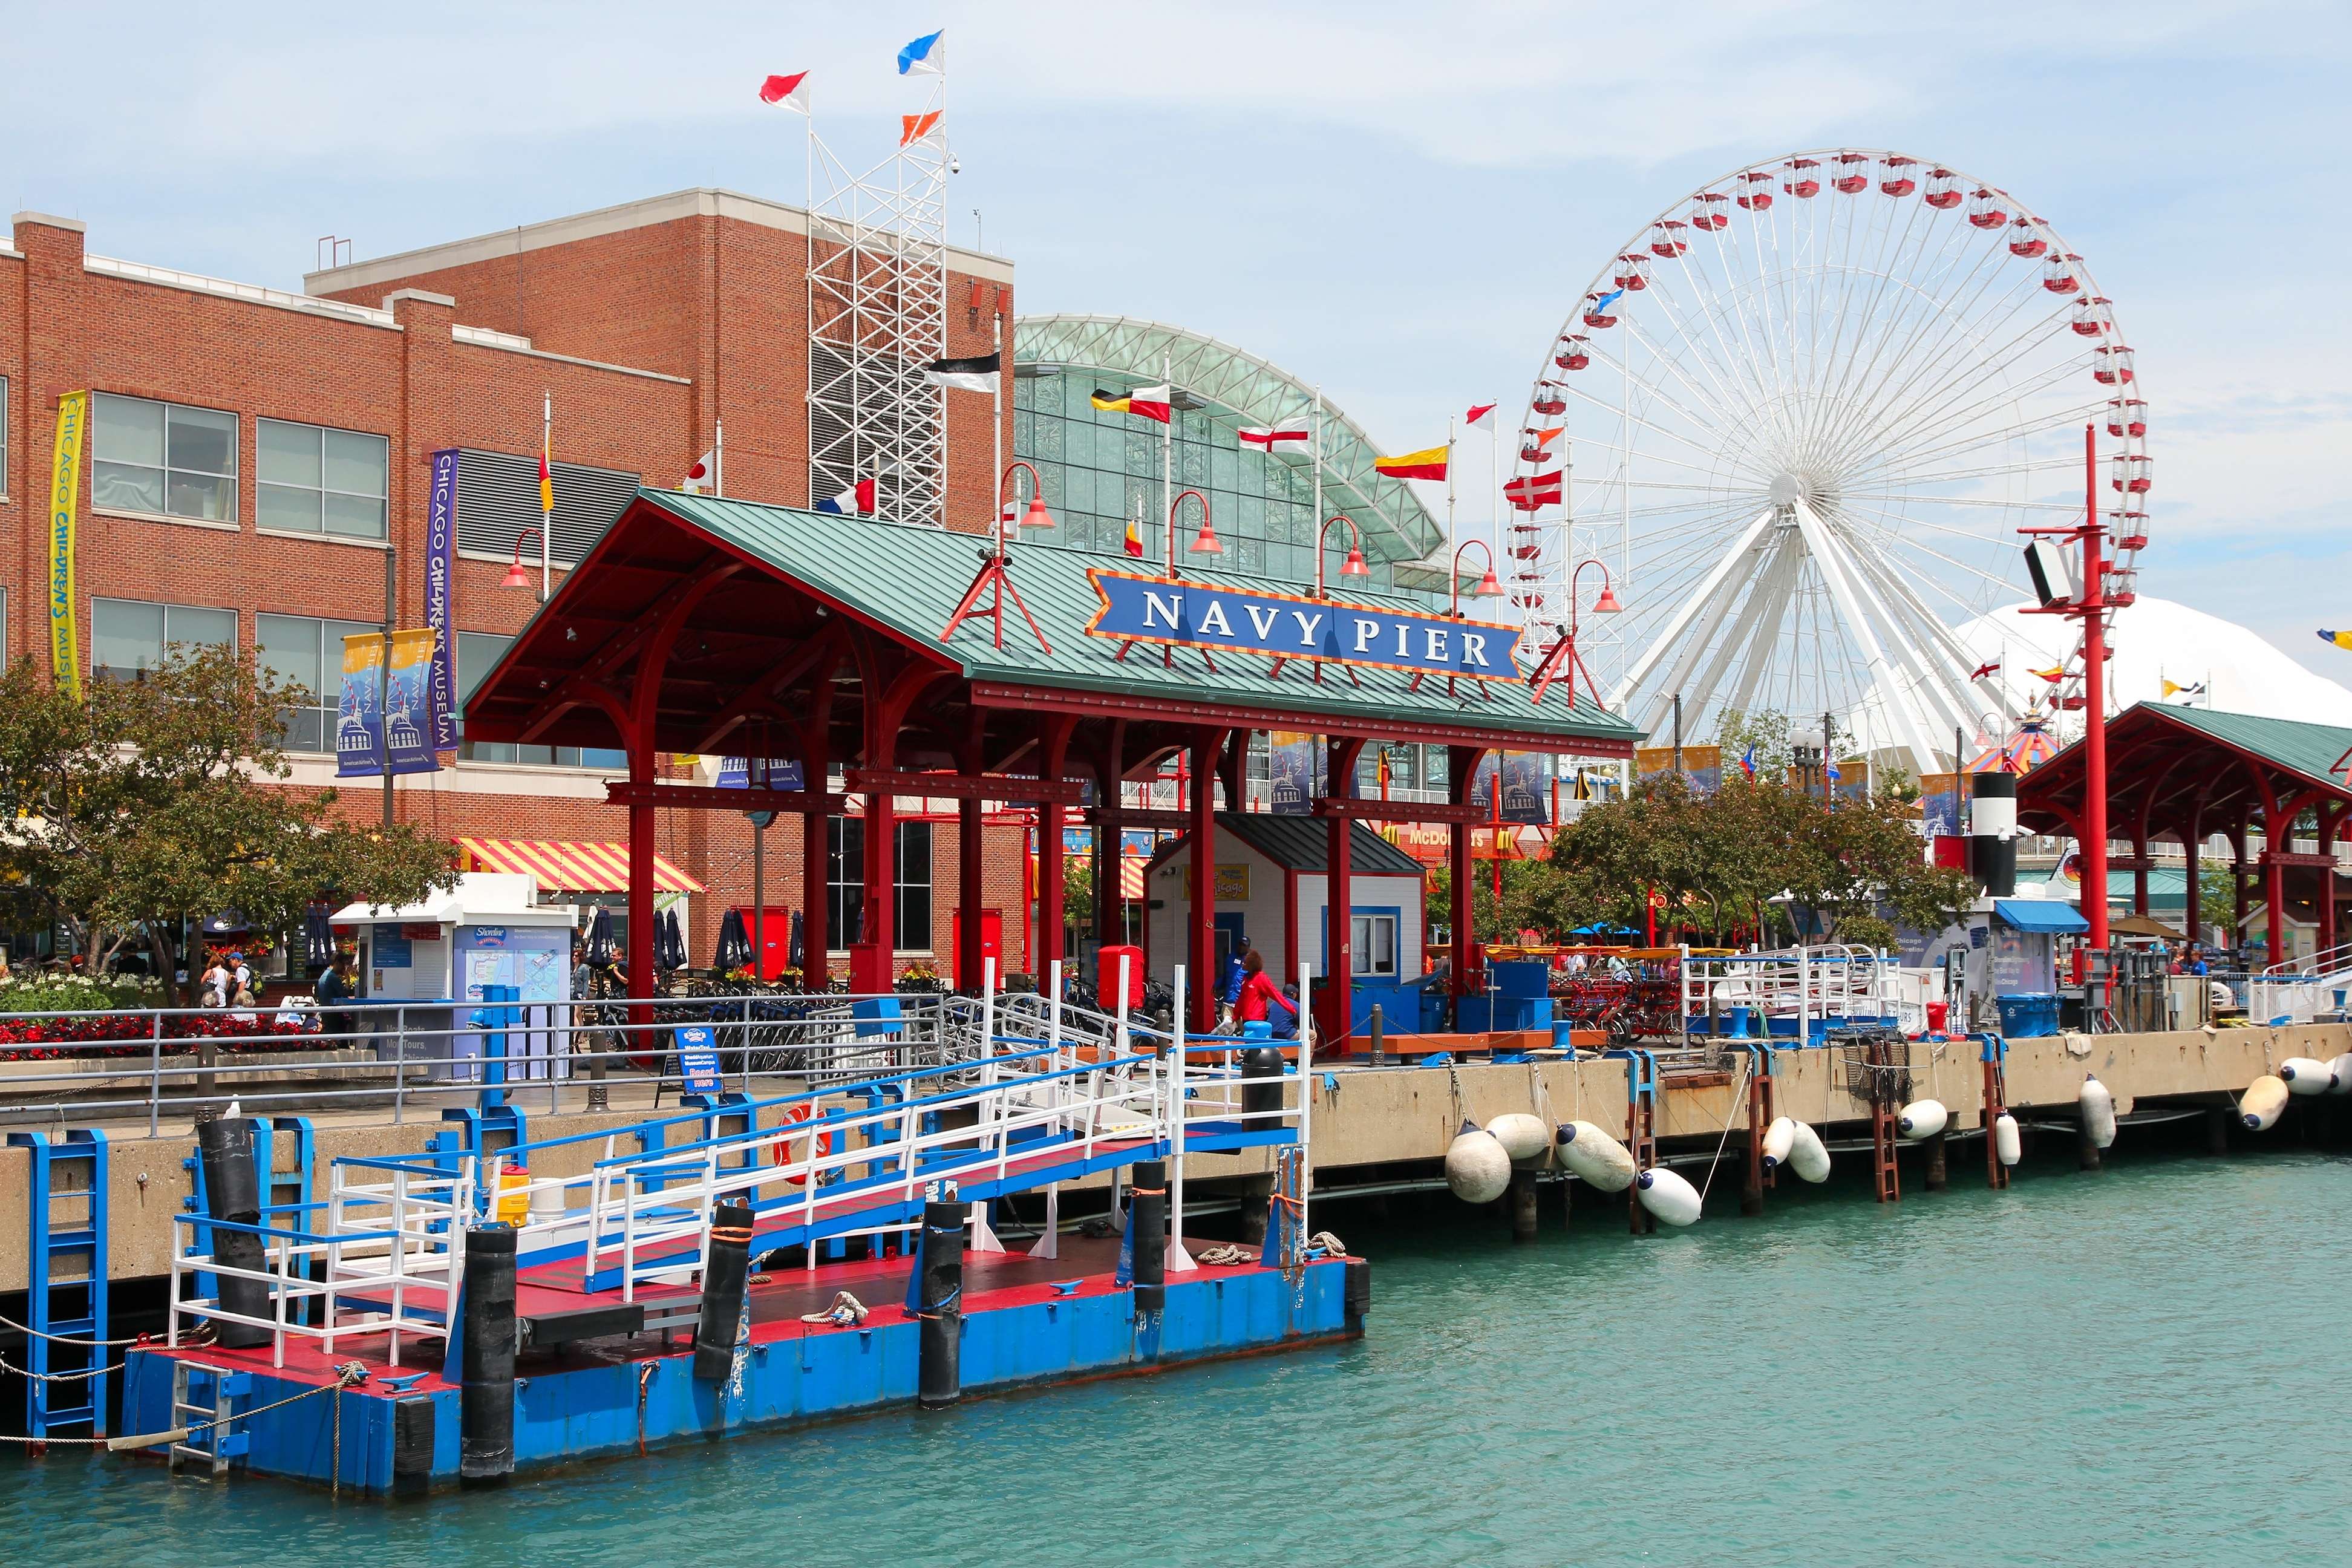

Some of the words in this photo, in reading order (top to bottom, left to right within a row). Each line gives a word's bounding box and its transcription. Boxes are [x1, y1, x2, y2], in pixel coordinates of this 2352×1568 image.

[58, 399, 77, 503] CHICAGO
[433, 455, 451, 550] CHICAGO
[52, 512, 68, 619] CHILDREN'S
[429, 556, 446, 653] CHILDREN'S
[1142, 591, 1323, 646] NAVY
[1354, 619, 1490, 667] PIER
[58, 627, 73, 688] MUSE
[367, 640, 378, 671] PIER
[412, 672, 420, 710] NAVY
[416, 636, 427, 667] PIER
[364, 675, 373, 714] NAVY
[434, 660, 450, 744] MUSEUM
[1295, 748, 1303, 776] NAVY
[476, 927, 504, 936] Shoreline
[403, 1039, 426, 1050] Tours,
[690, 1067, 714, 1076] Board
[694, 1079, 713, 1088] Here
